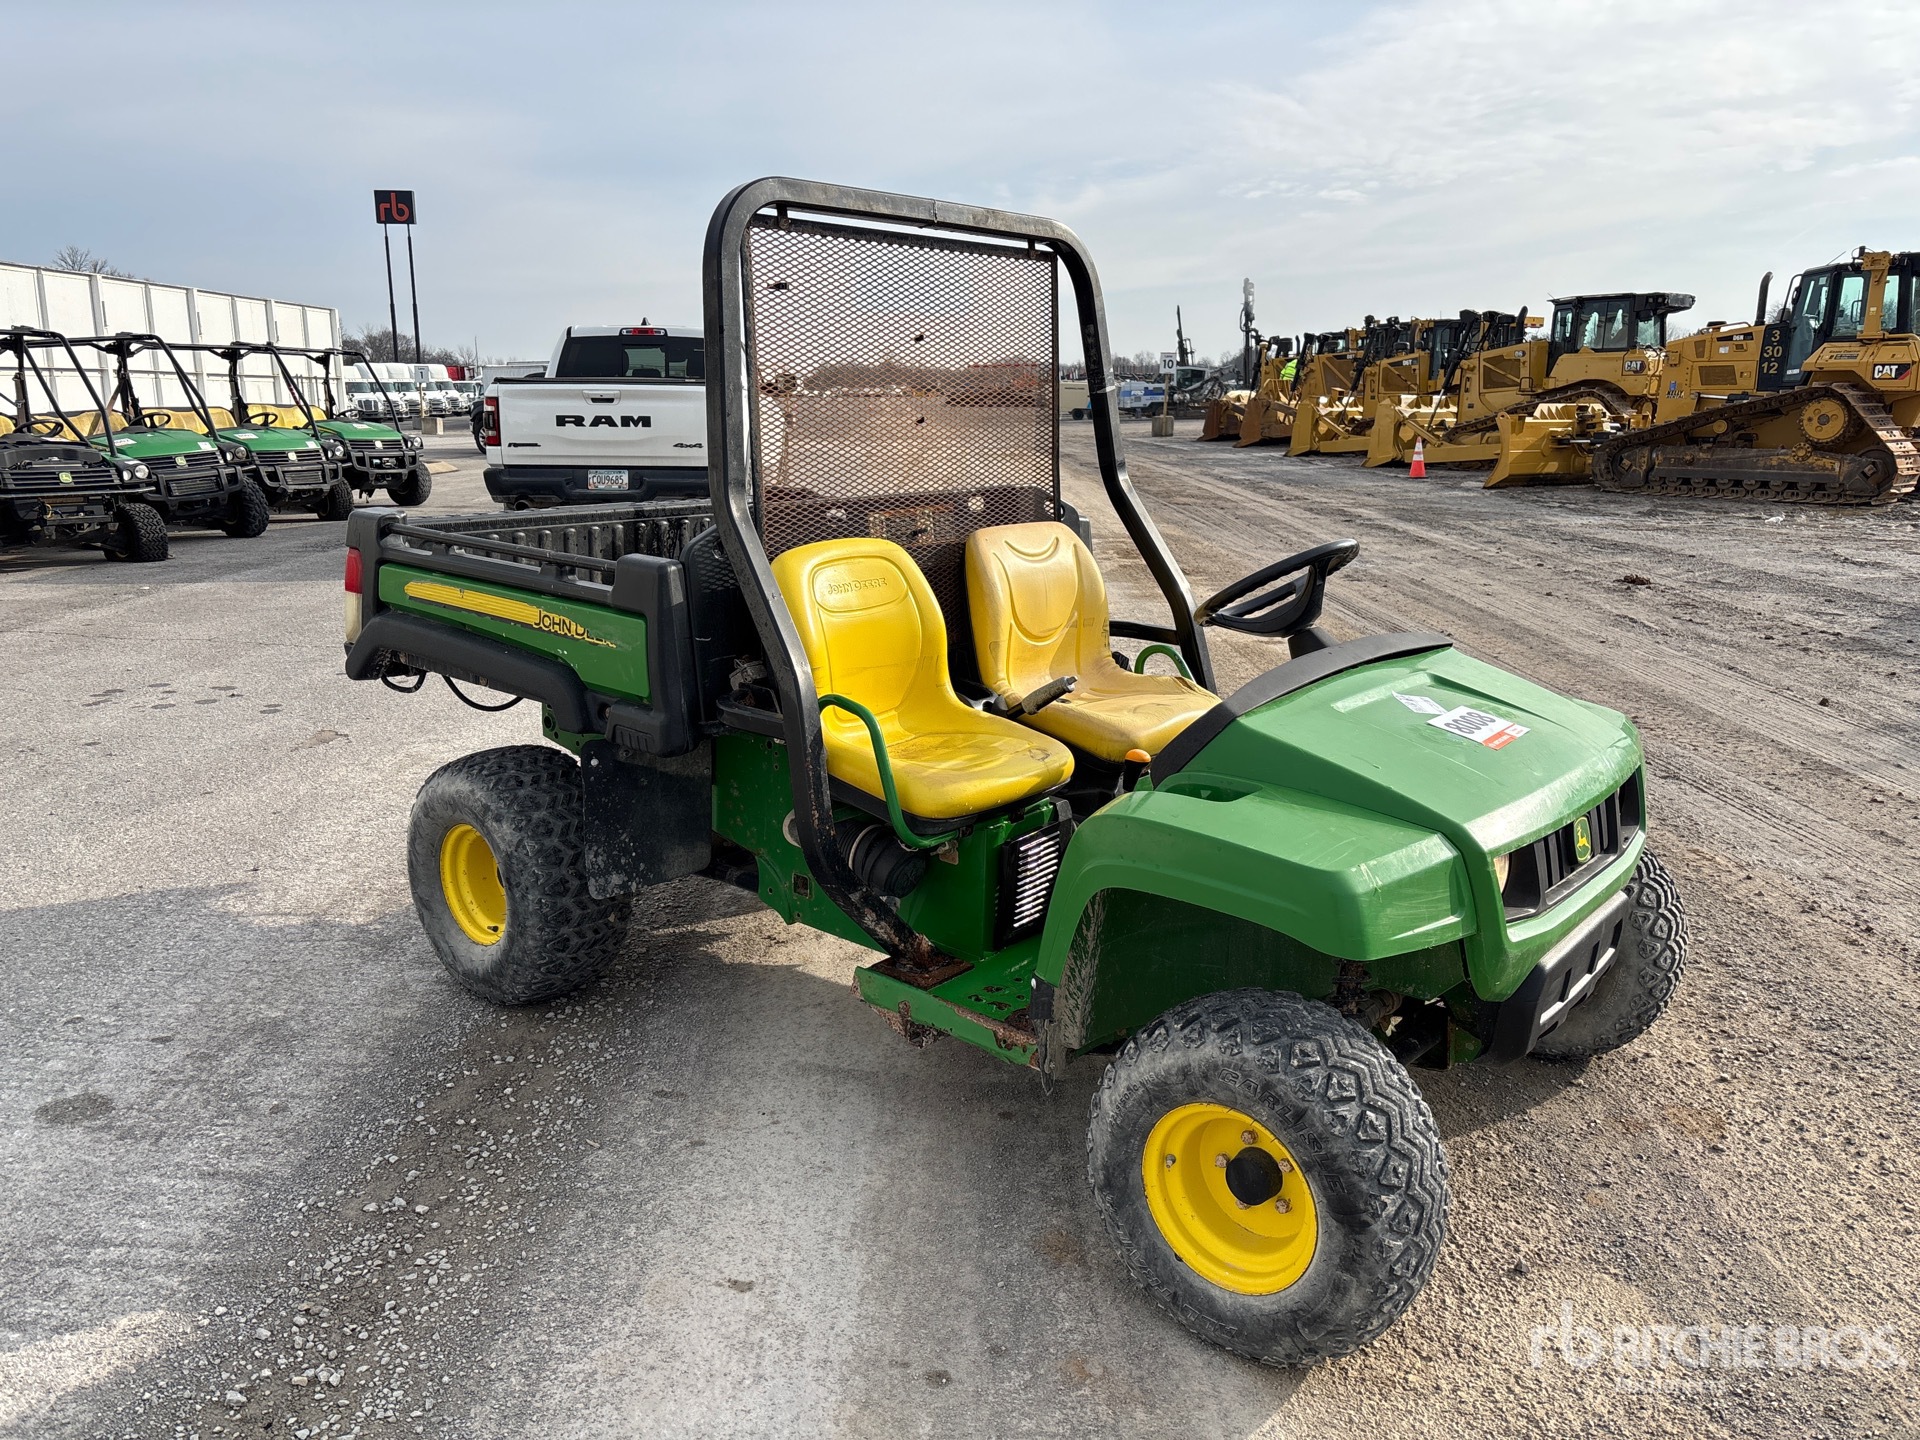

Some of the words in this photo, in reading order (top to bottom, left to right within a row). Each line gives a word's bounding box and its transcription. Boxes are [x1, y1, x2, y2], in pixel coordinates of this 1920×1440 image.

[379, 192, 410, 222] rb
[1771, 330, 1780, 341] 3
[1763, 346, 1783, 358] 30
[1162, 359, 1174, 369] 10
[1624, 360, 1642, 371] CAT
[1762, 362, 1779, 374] 12
[419, 371, 424, 379] 1
[1873, 365, 1899, 379] CAT
[555, 414, 652, 428] RAM
[828, 583, 853, 595] JOHN
[852, 577, 888, 592] DEERE
[533, 609, 572, 635] JOHN
[1443, 711, 1496, 735] 8008
[1217, 1067, 1348, 1195] CARLISLE
